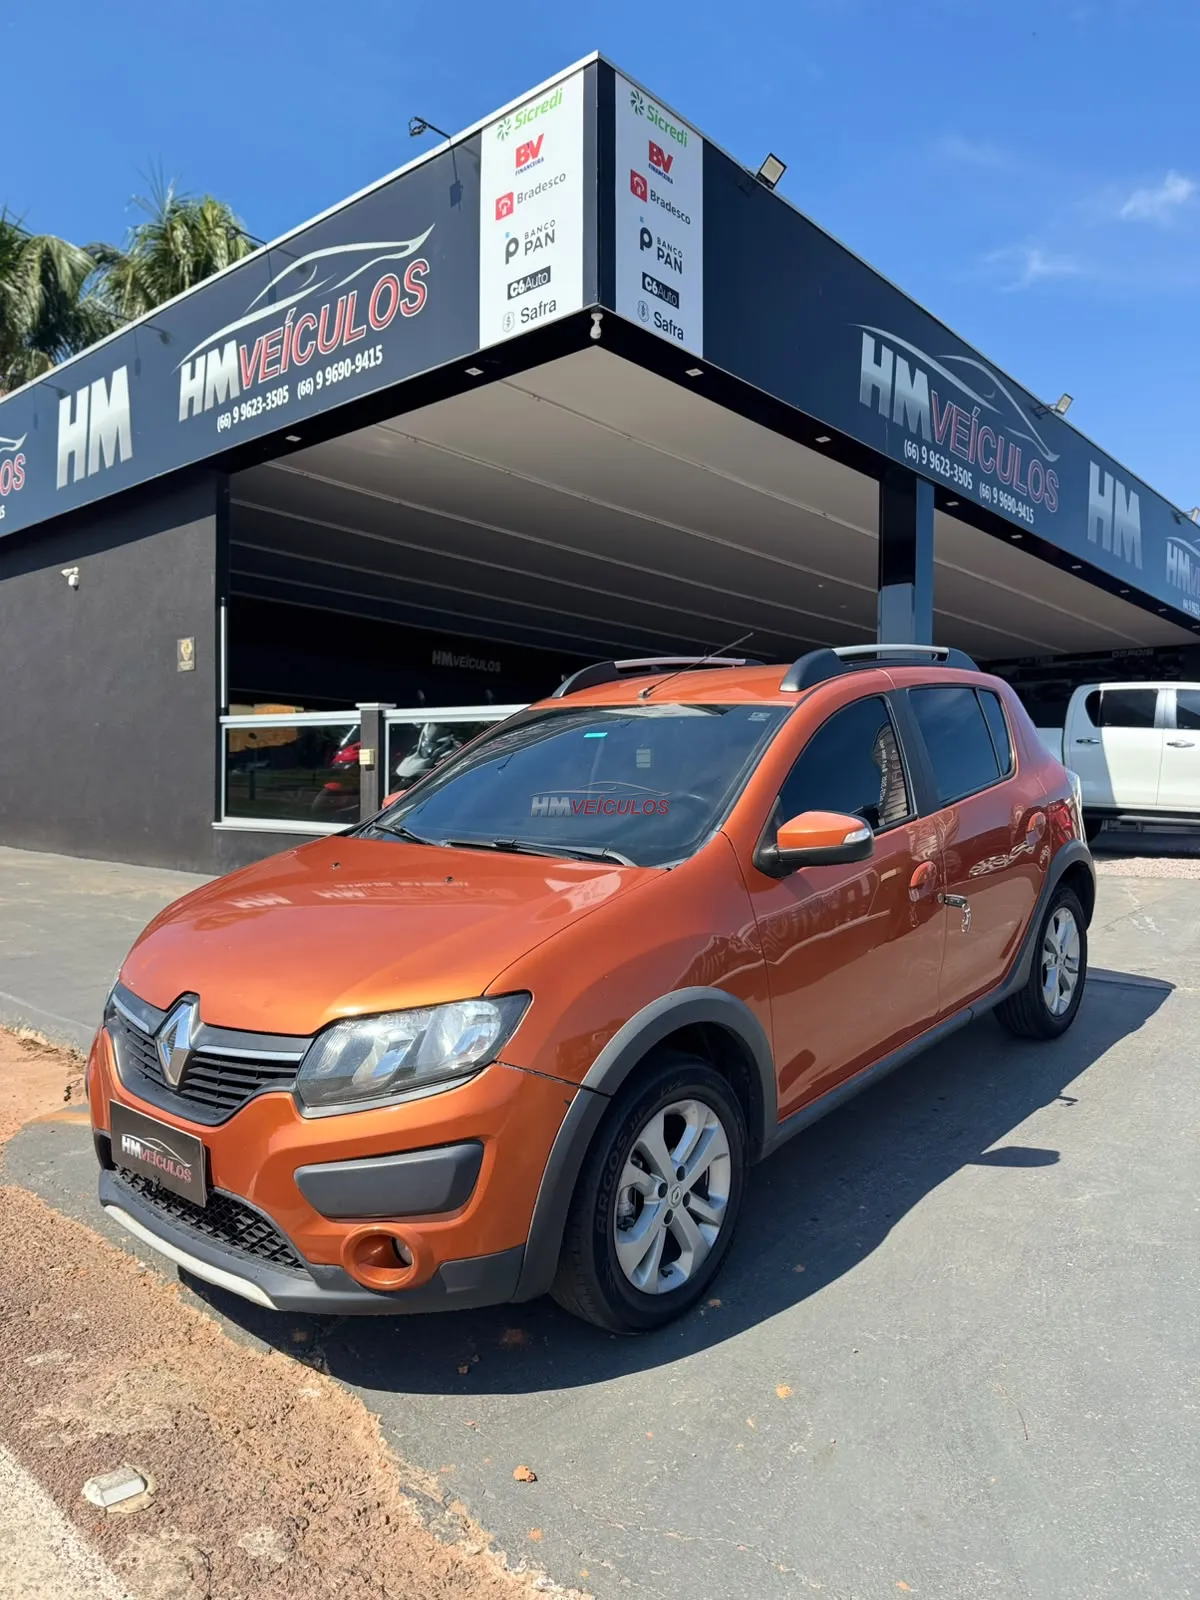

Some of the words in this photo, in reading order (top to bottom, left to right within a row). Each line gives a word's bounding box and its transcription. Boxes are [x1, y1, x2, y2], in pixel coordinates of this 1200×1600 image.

[515, 87, 563, 130] Sicredi
[646, 105, 688, 148] Sicredi
[515, 134, 544, 168] BV
[648, 140, 673, 174] BV
[517, 172, 566, 204] Bradesco
[650, 189, 691, 225] Bradesco
[524, 219, 556, 240] BANCO
[524, 229, 555, 256] PAN
[656, 236, 683, 259] BANCO
[656, 249, 683, 275] PAN
[520, 299, 557, 324] Safra
[654, 310, 684, 341] Safra
[217, 412, 231, 433] (66)
[233, 406, 239, 424] 9
[240, 385, 289, 422] 9623-3505
[297, 377, 314, 400] (66)
[316, 371, 323, 390] 9
[325, 344, 383, 387] 9690-9415
[56, 365, 133, 490] HM
[904, 439, 919, 464] (66)
[921, 446, 927, 465] 9
[929, 450, 973, 490] 9623-3505
[979, 481, 992, 503] (66)
[993, 487, 998, 504] 9
[999, 490, 1034, 524] 9690-9415
[1087, 460, 1143, 570] HM
